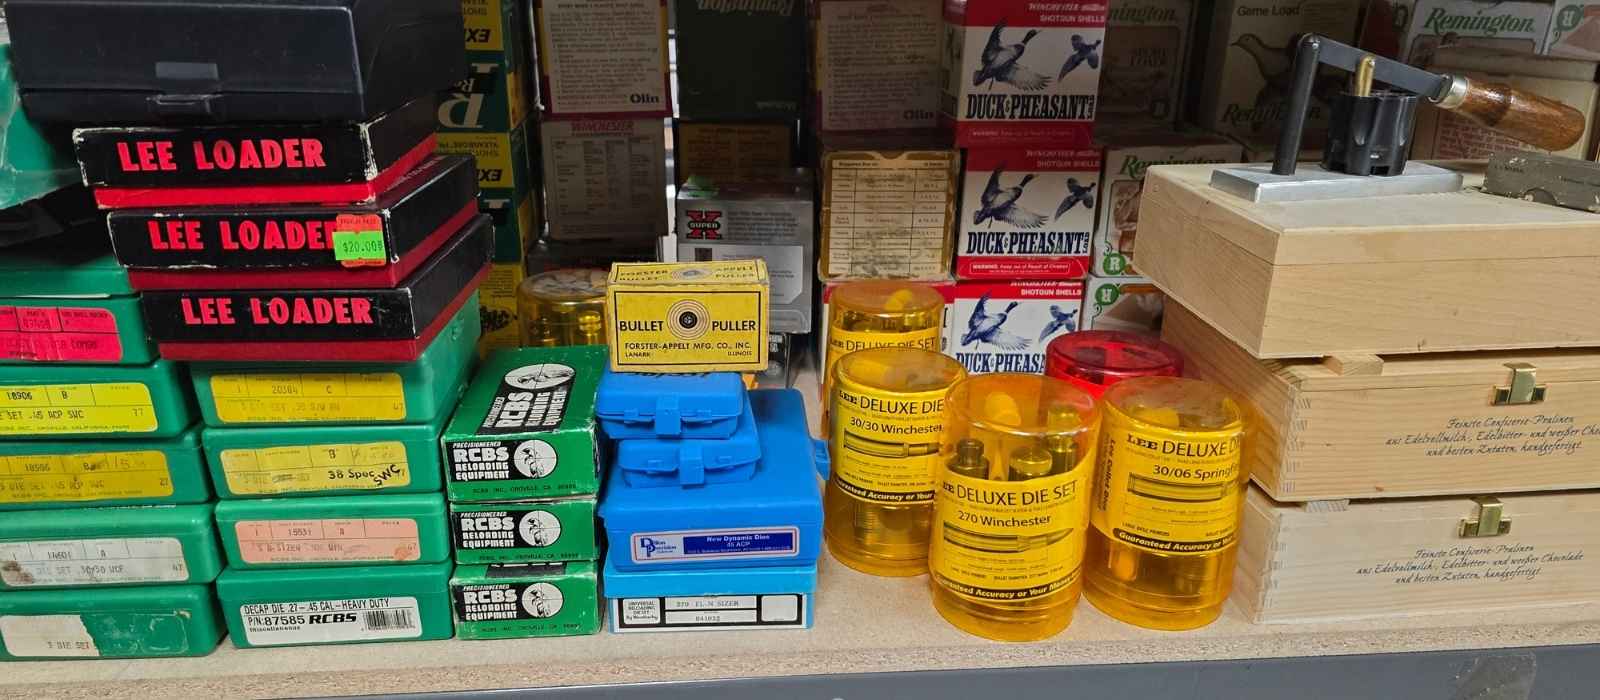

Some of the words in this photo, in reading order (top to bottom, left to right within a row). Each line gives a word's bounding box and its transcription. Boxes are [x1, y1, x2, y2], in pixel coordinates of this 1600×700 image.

[1237, 6, 1269, 16] Game
[1271, 5, 1301, 16] Load
[1039, 14, 1077, 23] SHOTGUN
[1077, 14, 1105, 23] SHELLS
[630, 93, 659, 104] Olin
[967, 94, 1007, 118] DUCK
[1010, 94, 1089, 119] PHEASANT
[115, 140, 177, 172] LEE
[193, 138, 326, 171] LOADER
[147, 220, 204, 251] LEE
[343, 240, 377, 252] $20.00
[966, 232, 1005, 254] DUCK
[1009, 232, 1085, 254] PHEASANT
[1021, 289, 1055, 297] SHOTGUN
[1056, 289, 1082, 297] SHELLS
[181, 297, 236, 326] LEE
[253, 297, 374, 325] LOADER
[619, 320, 664, 332] BULLET
[711, 320, 756, 332] PULLER
[625, 342, 689, 350] FORSTER-APPELT
[735, 341, 752, 349] INC.
[918, 337, 936, 350] SET
[494, 392, 534, 428] RCBS
[860, 396, 917, 415] DELUXE
[922, 398, 944, 414] DIE
[849, 417, 878, 432] 30/30
[881, 423, 944, 435] Winchester
[1127, 433, 1158, 450] LEE
[1161, 440, 1227, 457] DELUXE
[453, 446, 510, 462] RCBS
[455, 462, 509, 472] RELOADING
[1152, 464, 1191, 479] 30/06
[328, 470, 344, 480] 38
[455, 470, 509, 481] EQUIPMENT
[867, 491, 904, 502] Accuracy
[957, 484, 1017, 505] DELUXE
[1021, 488, 1049, 505] DIE
[1053, 479, 1078, 500] SET
[461, 516, 515, 531] RCBS
[958, 510, 978, 524] 270
[979, 514, 1052, 528] Winchester
[462, 531, 514, 540] RELOADING
[706, 535, 722, 543] New
[723, 535, 753, 543] Dynamic
[1119, 531, 1171, 550] Guaranteed
[1172, 542, 1212, 551] Accuracy
[1213, 541, 1221, 549] or
[462, 539, 515, 549] EQUIPMENT
[463, 589, 518, 604] RCBS
[976, 589, 1015, 599] Accuracy
[1029, 586, 1048, 596] Your
[245, 604, 269, 615] DECAP
[271, 603, 285, 614] DIE
[319, 601, 334, 612] CAL
[342, 599, 366, 611] HEAVY
[369, 598, 389, 609] DUTY
[465, 603, 517, 612] RELOADING
[248, 614, 306, 627] P/N:87585
[308, 612, 358, 625] RCBS
[465, 611, 517, 621] EQUIPMENT
